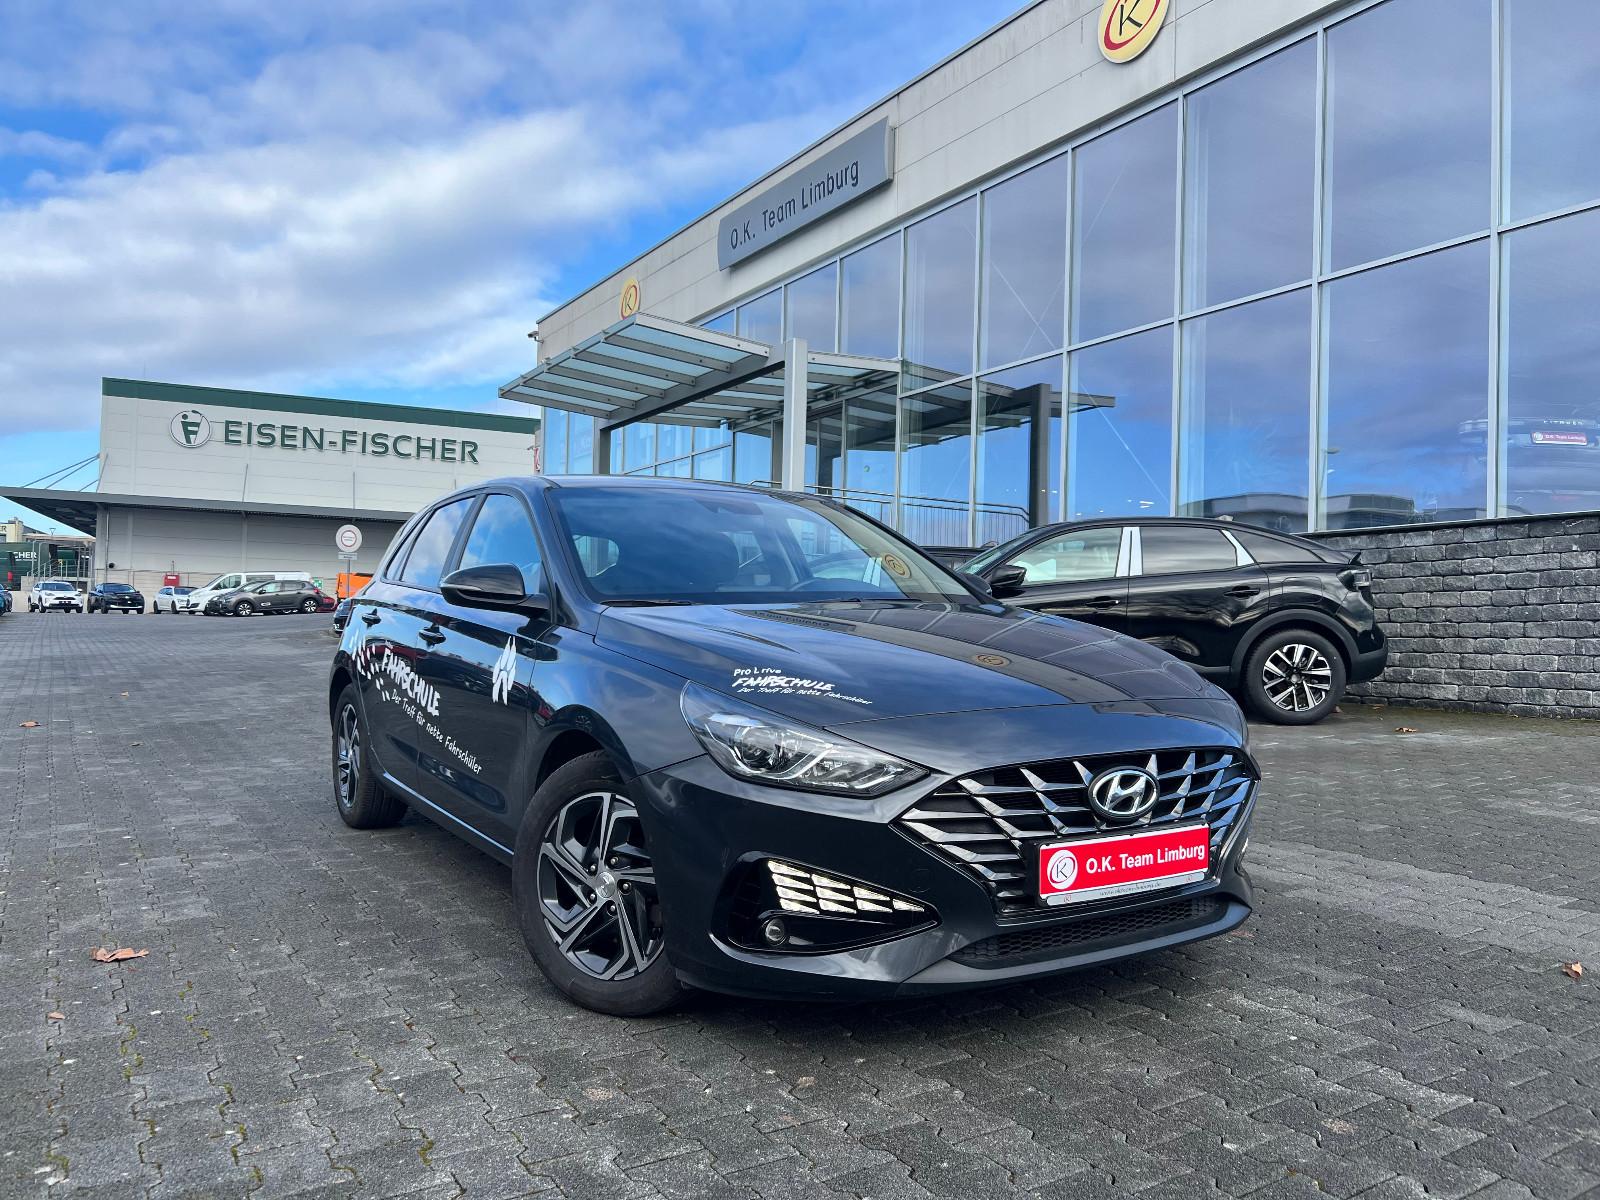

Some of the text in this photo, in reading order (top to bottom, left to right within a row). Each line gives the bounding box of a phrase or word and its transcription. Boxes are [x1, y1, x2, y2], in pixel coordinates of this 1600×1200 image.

[730, 160, 859, 250] O.K. Team Limburg
[224, 419, 480, 464] EISEN-FISCHER
[381, 647, 441, 717] FAHRSCHULE
[731, 675, 836, 691] FAHRSCHULE
[402, 697, 417, 719] Treff
[416, 711, 426, 726] für
[426, 722, 444, 743] nette
[444, 735, 482, 775] Fahrschüler
[1086, 844, 1205, 874] O.K. Team Limburg
